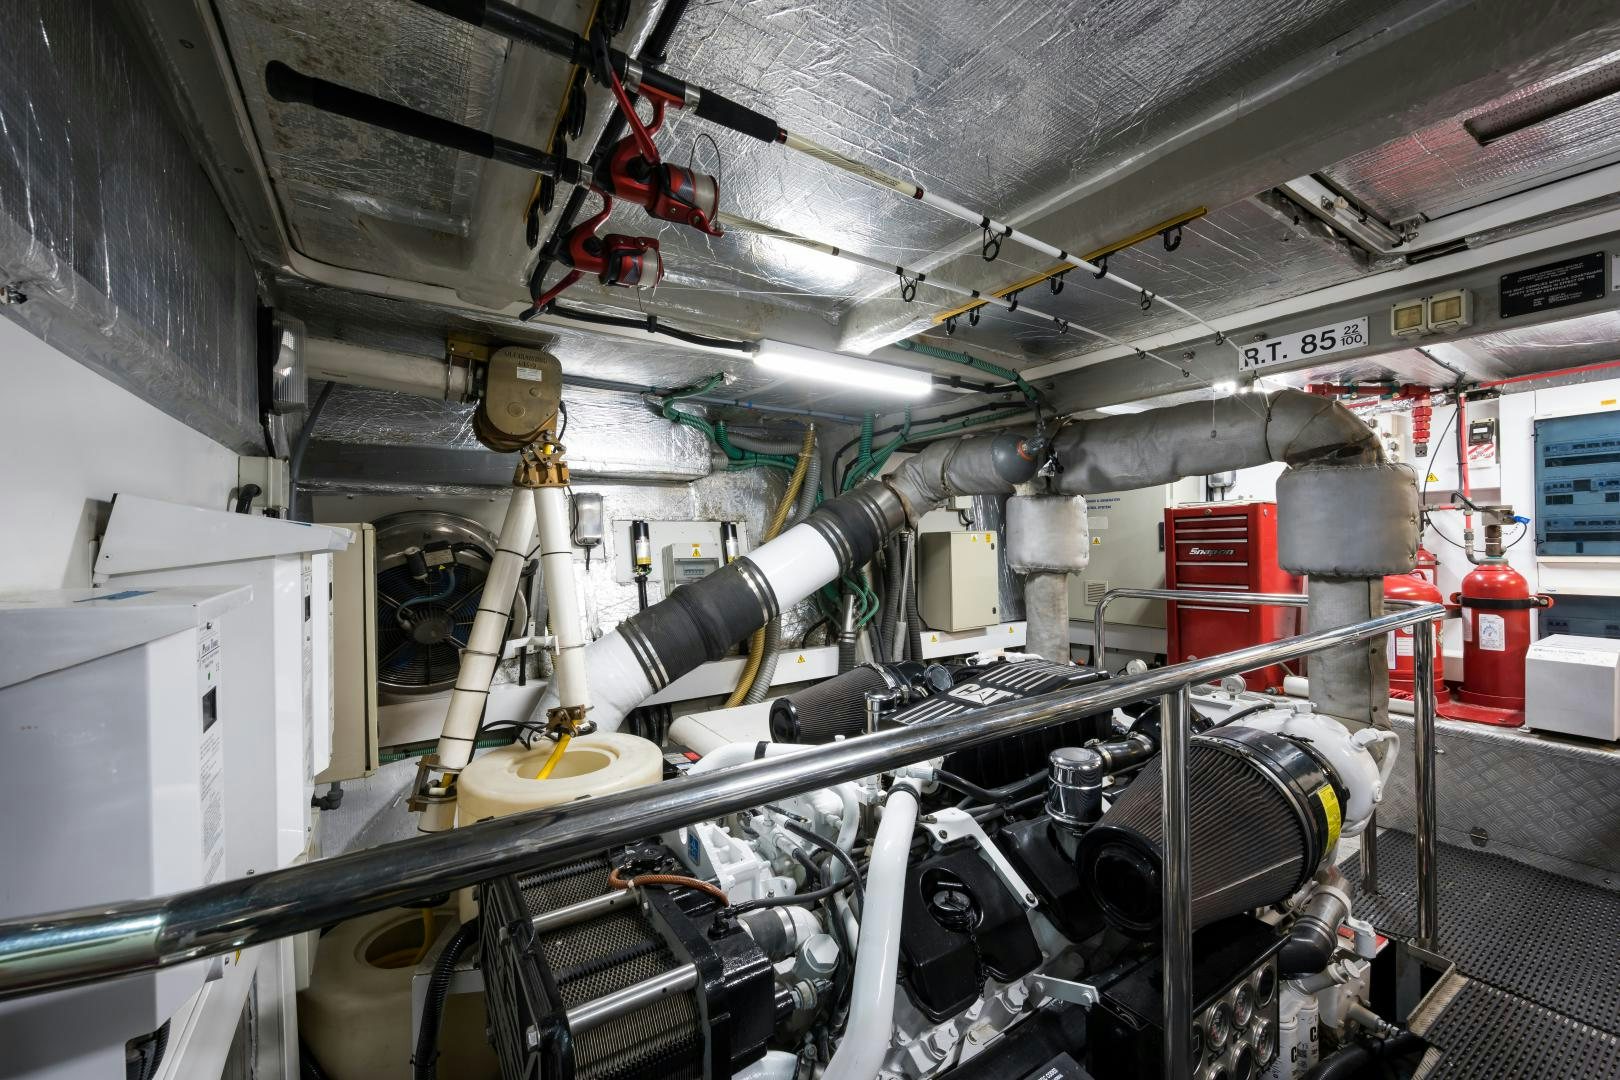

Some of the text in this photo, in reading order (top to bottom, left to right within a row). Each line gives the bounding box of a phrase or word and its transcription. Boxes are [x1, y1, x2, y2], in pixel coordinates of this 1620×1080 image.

[1244, 329, 1337, 367] R.T. 85
[948, 683, 1015, 706] CAT
